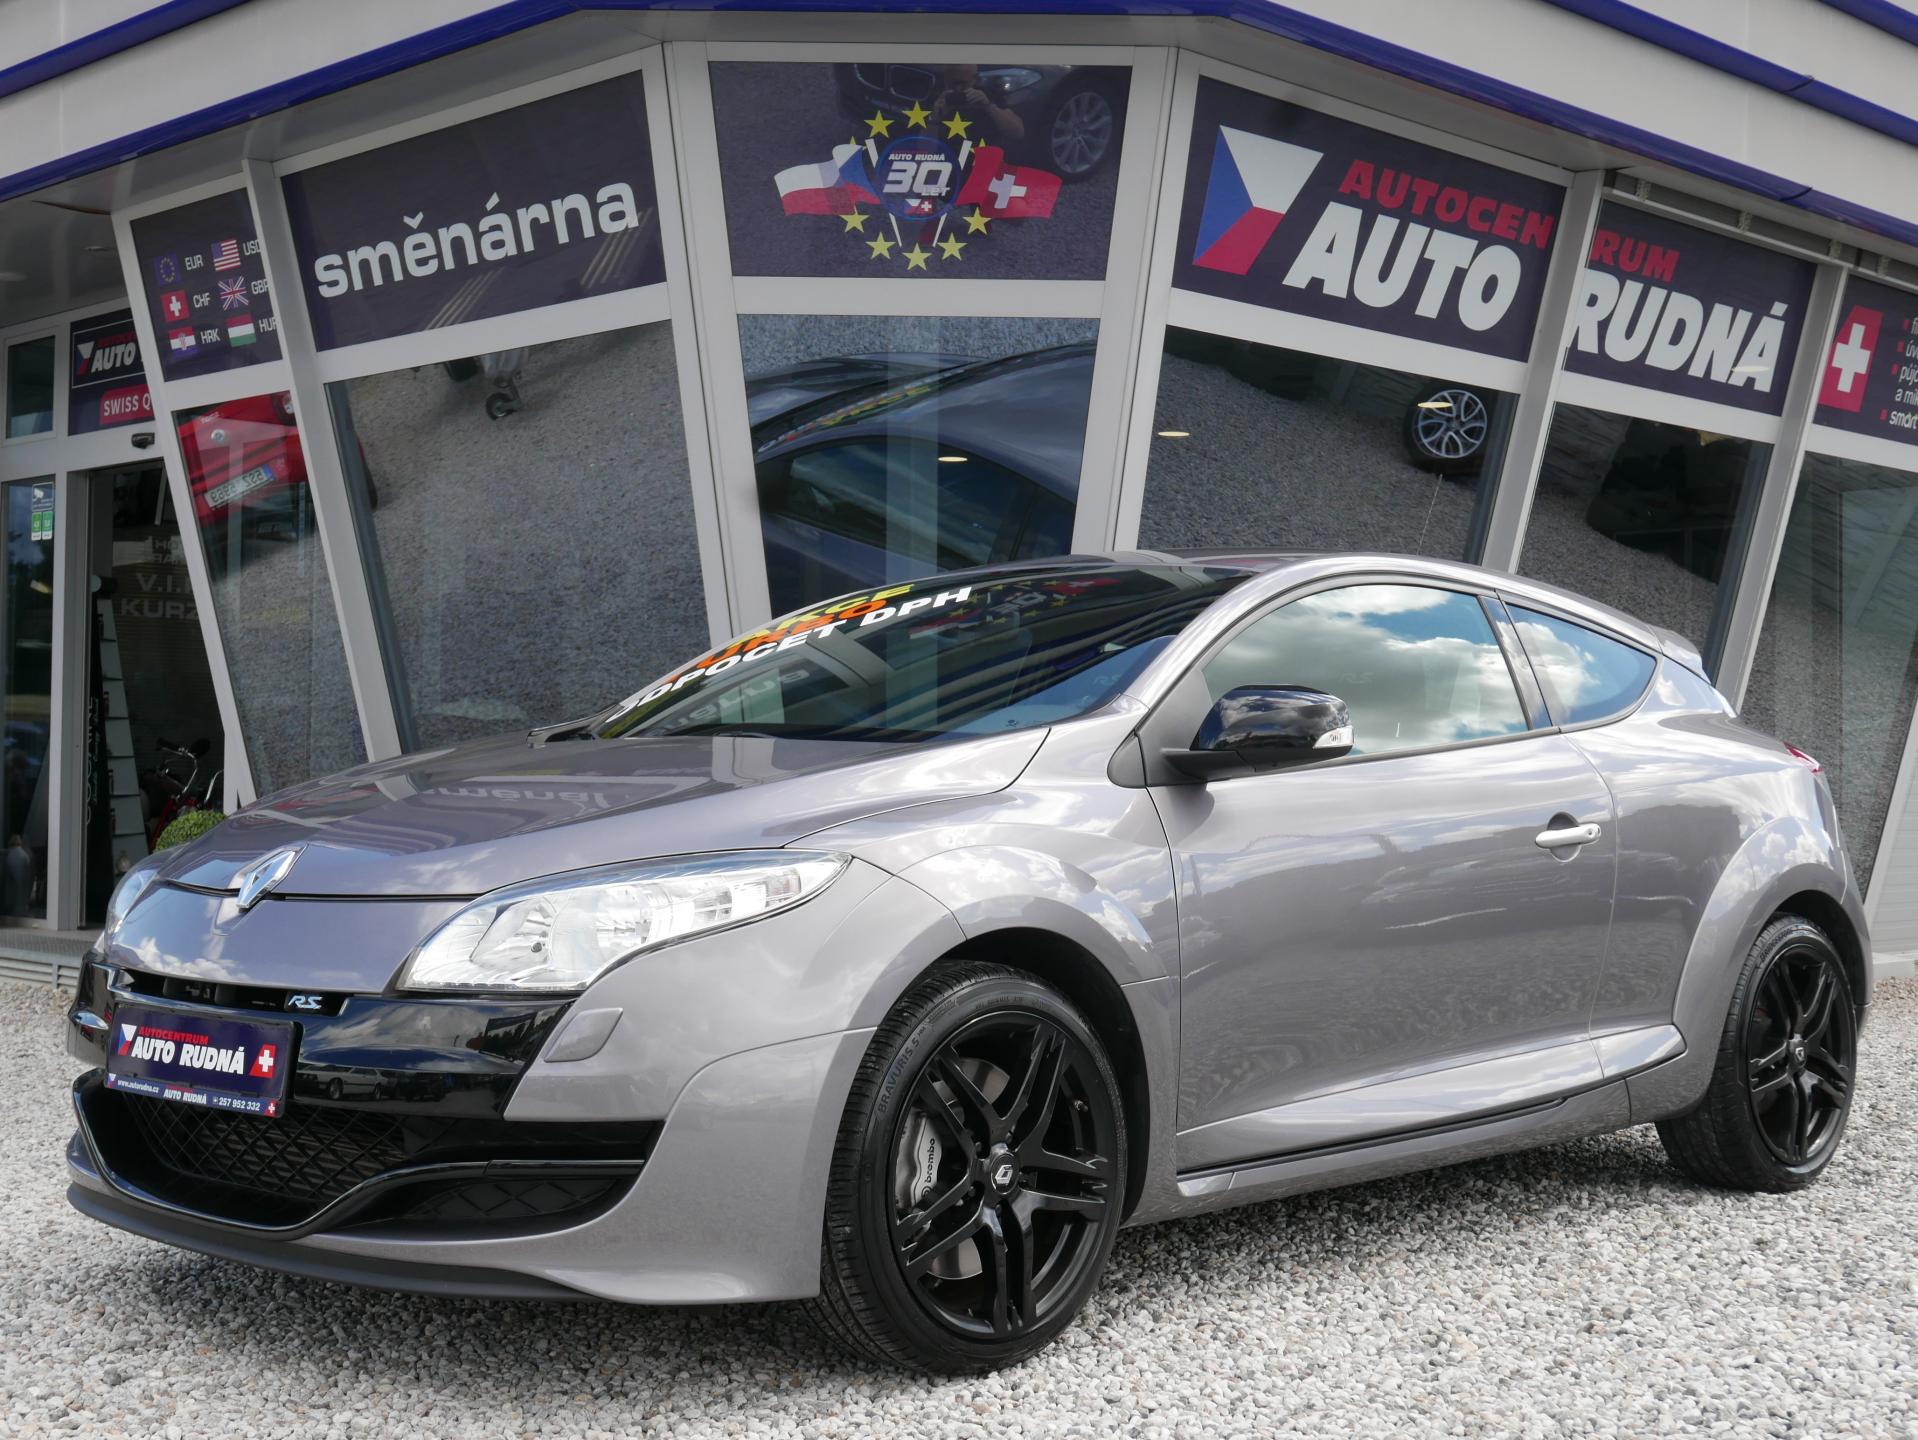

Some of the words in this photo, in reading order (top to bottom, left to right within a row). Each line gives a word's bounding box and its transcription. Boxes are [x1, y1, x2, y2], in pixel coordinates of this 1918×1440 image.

[883, 161, 953, 193] 30
[314, 182, 639, 298] směnárna
[184, 254, 204, 271] EUR
[193, 292, 211, 308] CHF
[1282, 201, 1521, 332] AUTO
[1566, 268, 1788, 393] RUDNÁ
[200, 328, 221, 344] HRK
[91, 342, 136, 373] AUTO
[1895, 388, 1903, 401] a
[103, 395, 139, 417] SWISS
[859, 586, 973, 627] DPH
[288, 995, 323, 1010] RS
[138, 1026, 209, 1045] AUTOCENTRUM
[131, 1036, 176, 1064] AUTO
[179, 1043, 245, 1075] RUDNÁ
[877, 1046, 914, 1114] BRAVURIS
[163, 1088, 182, 1101] AUTO
[182, 1092, 207, 1105] RUDNÁ
[218, 1096, 231, 1107] 257
[232, 1098, 245, 1110] 952
[246, 1101, 261, 1112] 332
[924, 1137, 936, 1184] brembo
